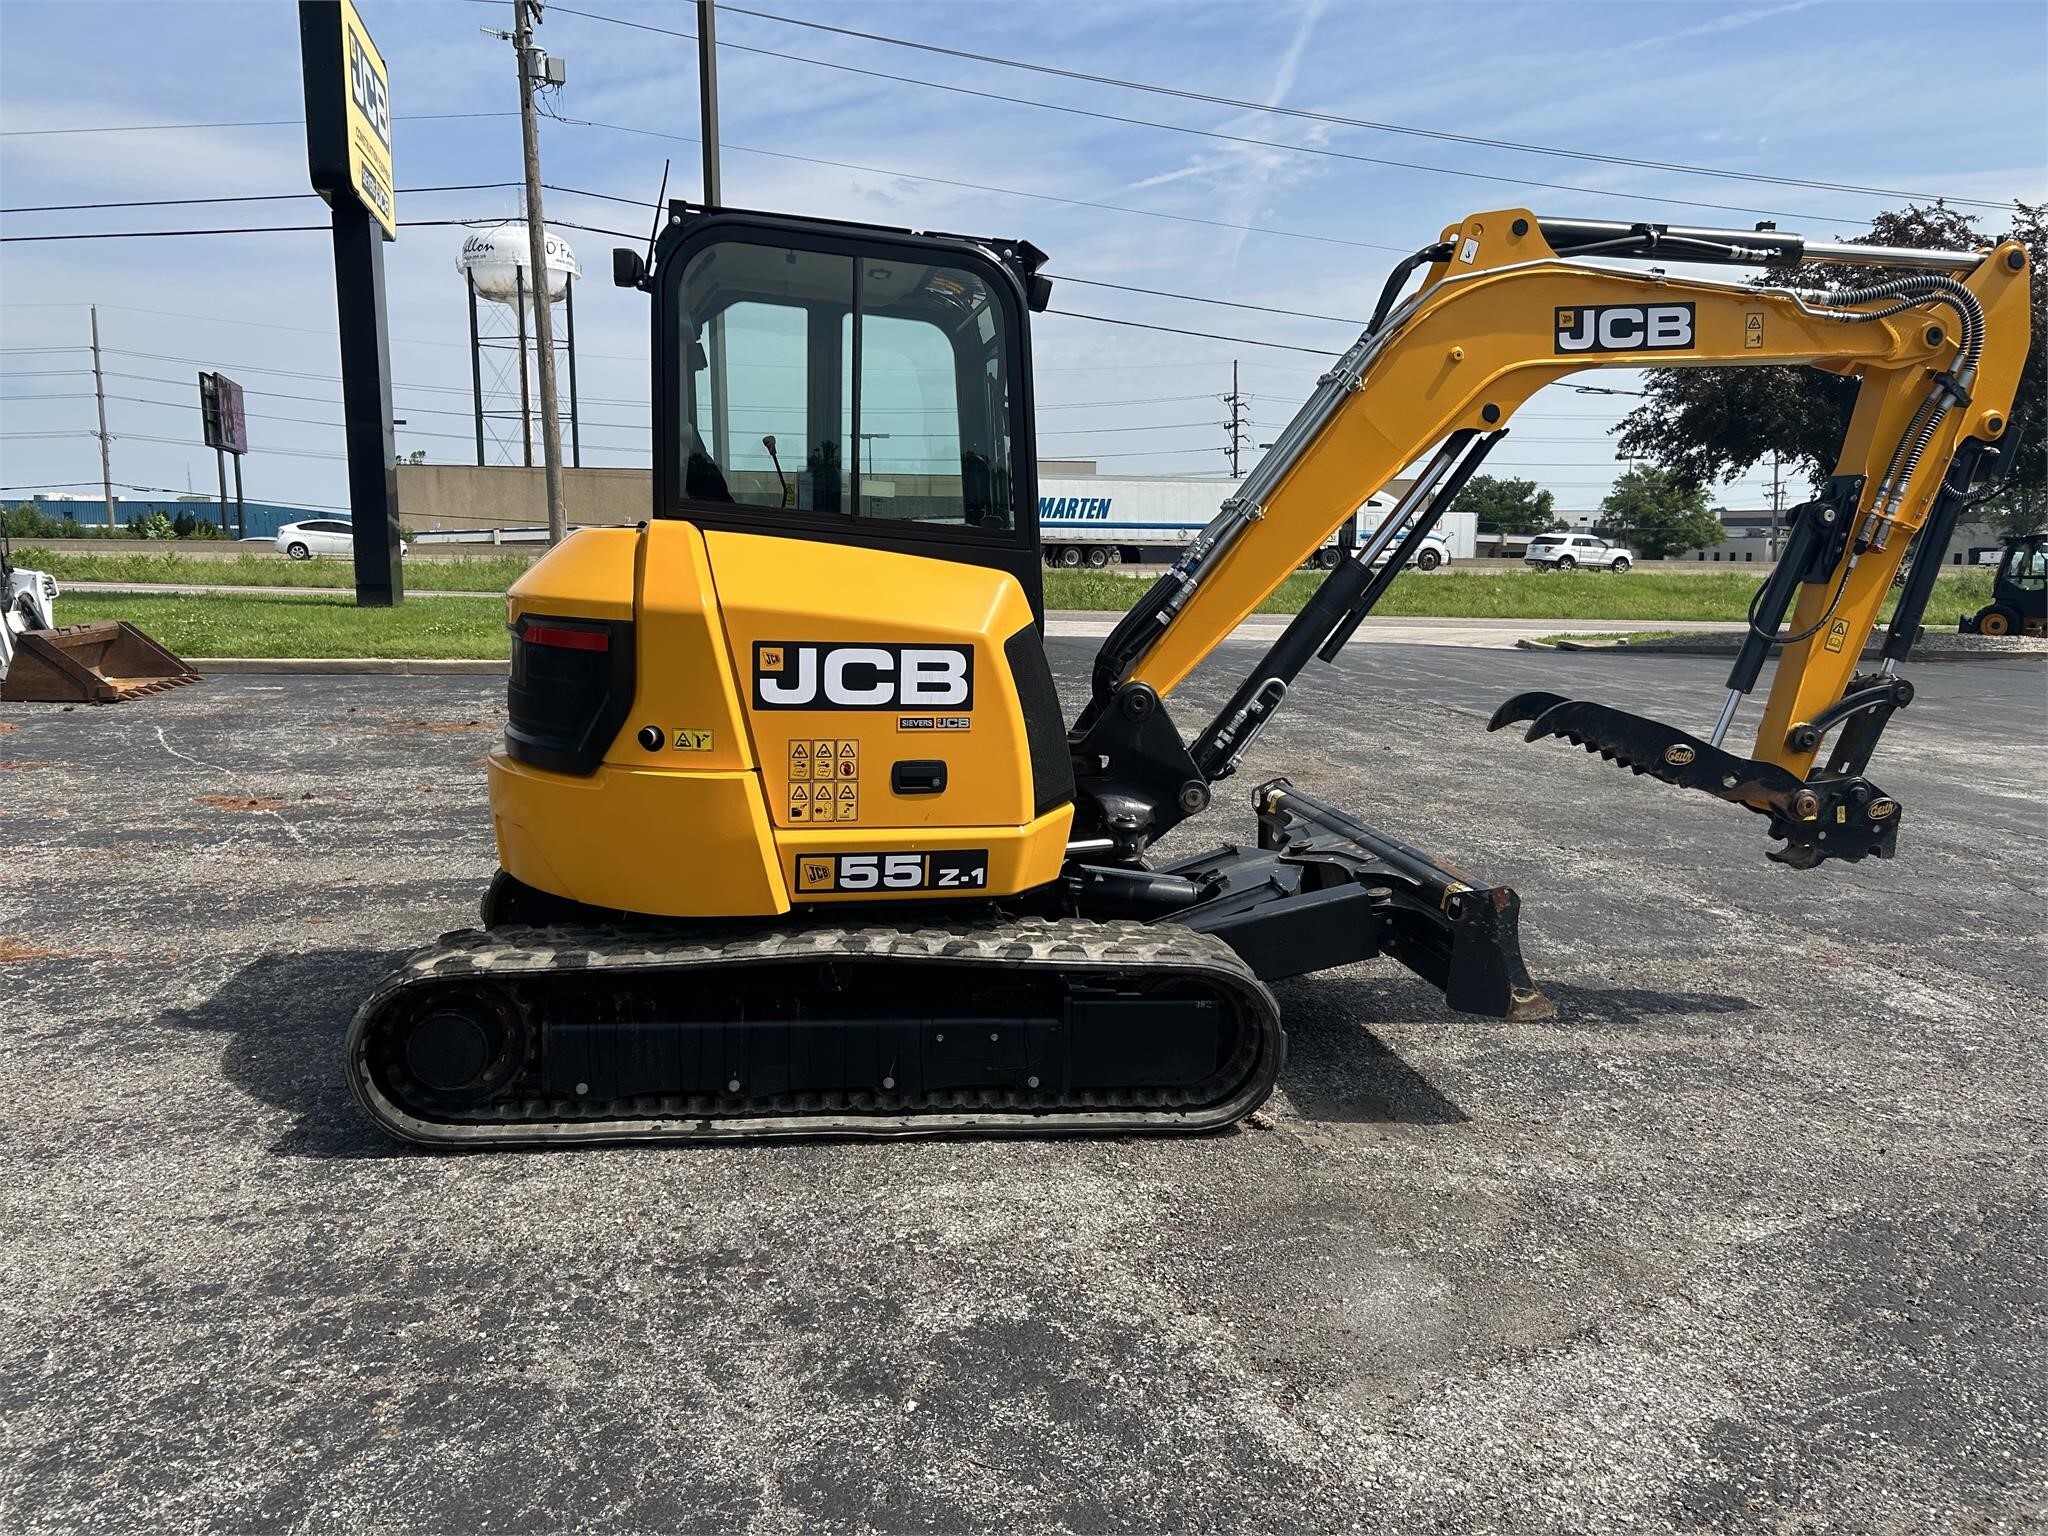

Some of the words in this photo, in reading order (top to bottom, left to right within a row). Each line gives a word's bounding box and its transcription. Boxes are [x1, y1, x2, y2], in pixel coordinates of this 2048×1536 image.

[351, 43, 388, 146] JCB
[1558, 306, 1692, 350] JCB
[1039, 497, 1112, 519] MARTEN
[760, 648, 968, 705] JCB
[901, 719, 933, 727] SIEVERS
[937, 718, 969, 728] JCB
[809, 864, 831, 882] JCB
[839, 854, 922, 889] 55
[938, 867, 984, 886] Z-1
